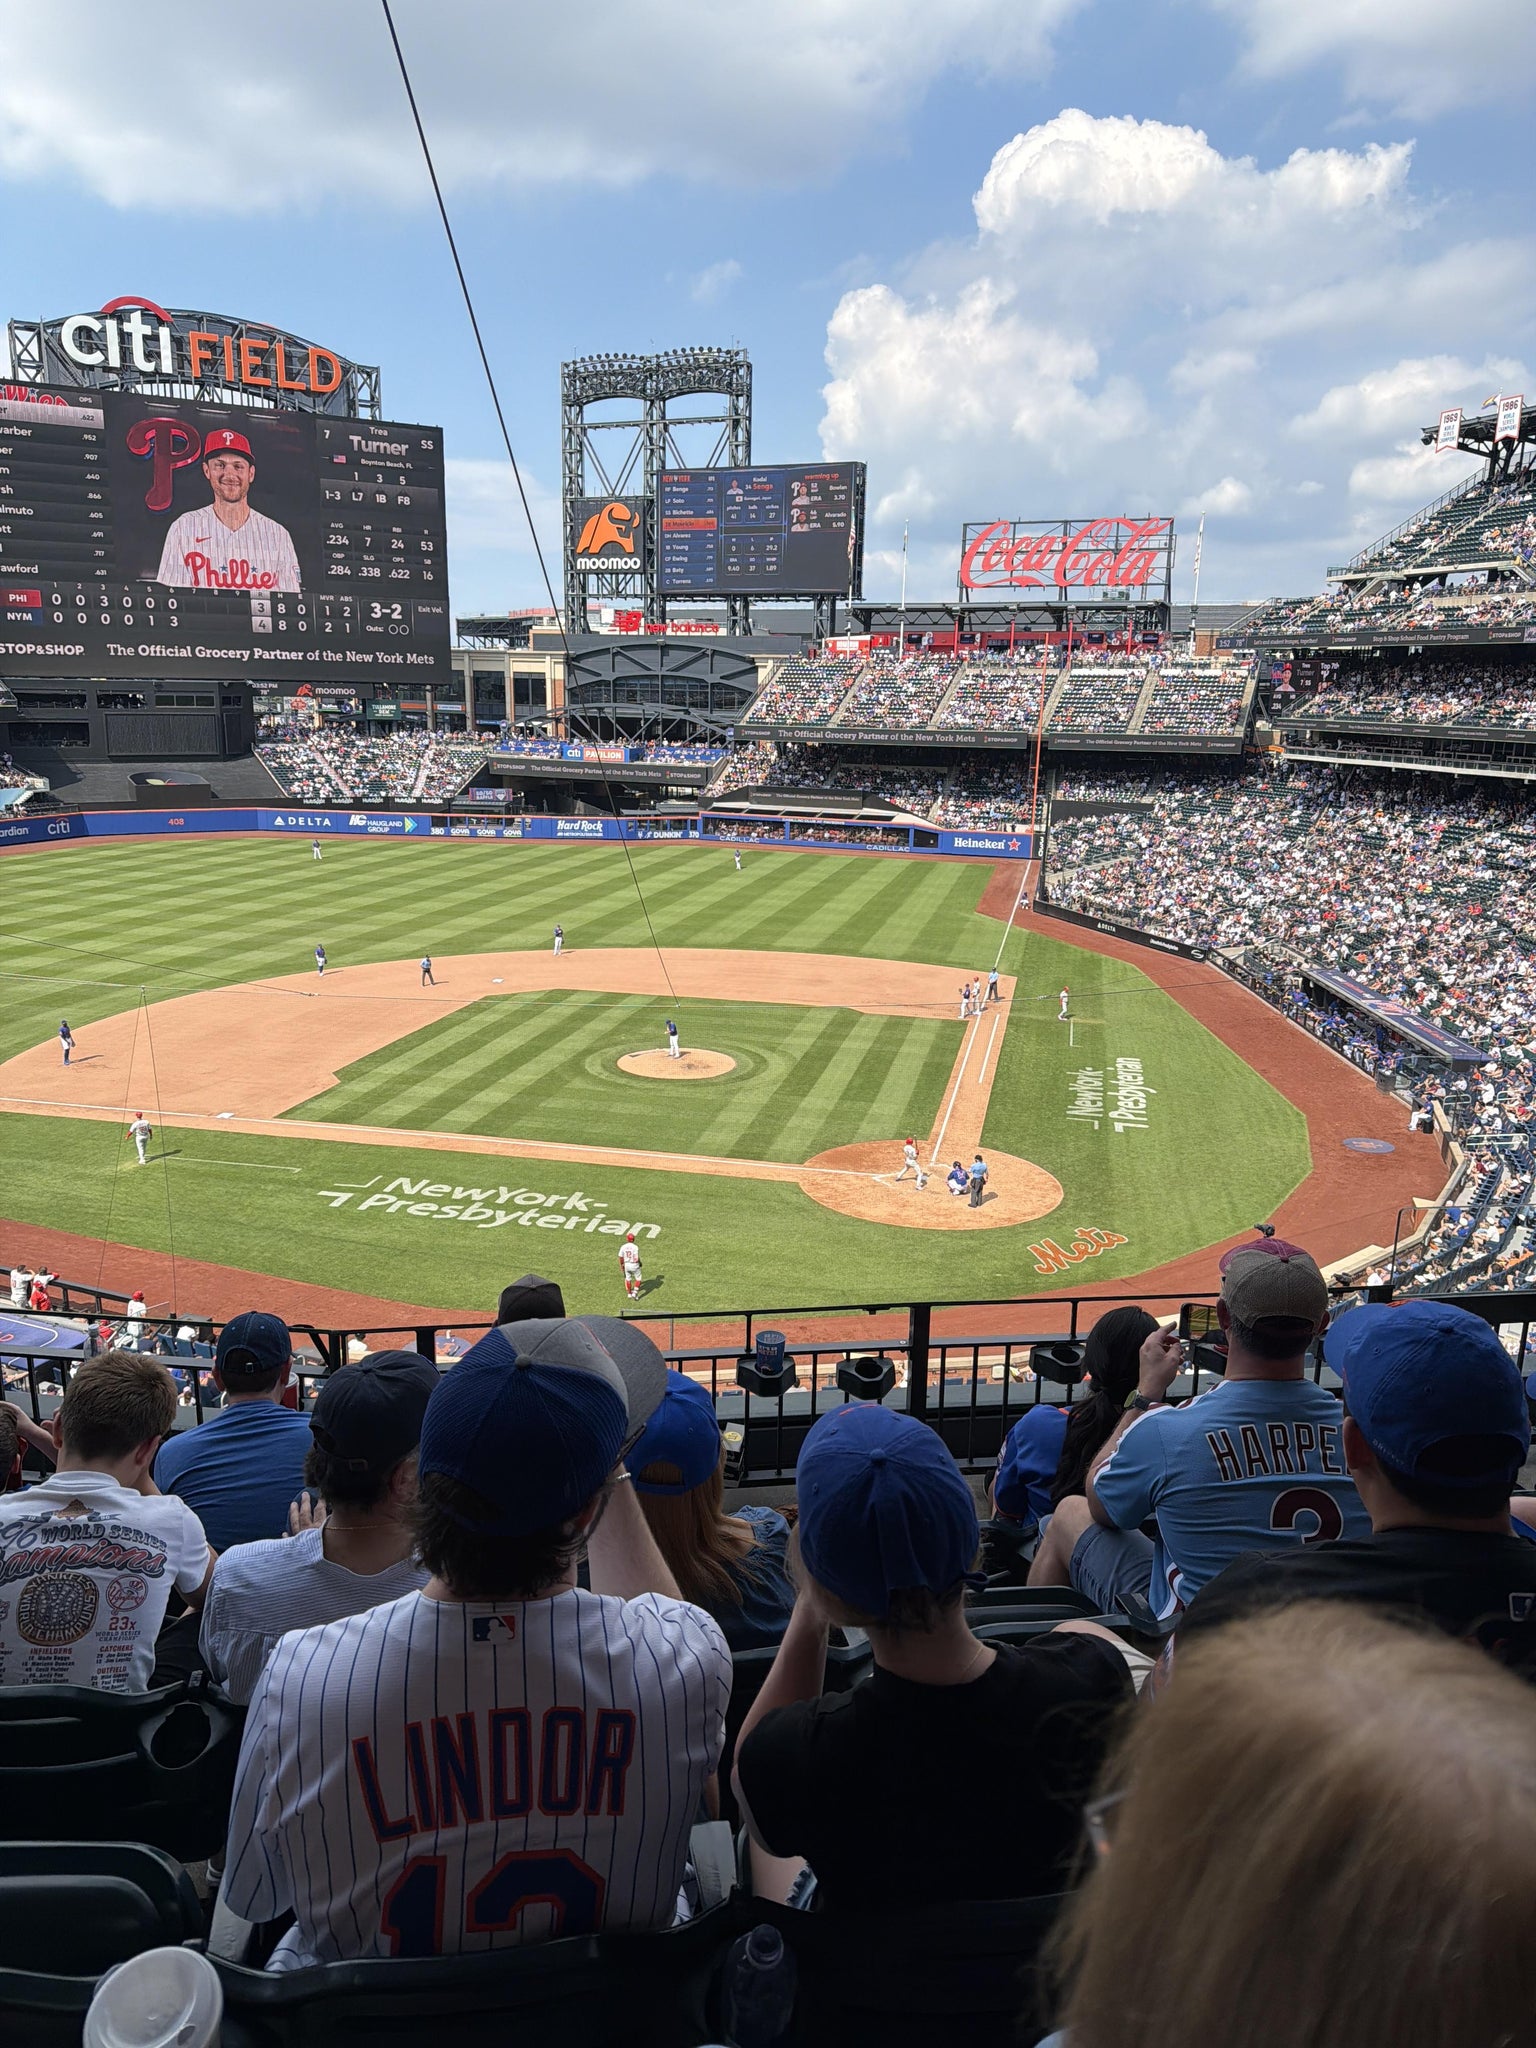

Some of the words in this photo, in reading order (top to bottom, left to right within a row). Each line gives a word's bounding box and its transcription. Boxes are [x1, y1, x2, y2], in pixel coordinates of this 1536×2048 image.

[61, 309, 173, 374] citi
[189, 331, 341, 392] FIELD
[1502, 400, 1519, 411] 1986
[1444, 413, 1458, 424] 1969
[324, 430, 330, 439] 7
[369, 427, 389, 436] Trea
[349, 435, 409, 456] Turner
[421, 440, 434, 450] SS
[354, 472, 359, 481] 1
[376, 474, 383, 483] 3
[399, 476, 406, 485] 5
[752, 483, 774, 491] Senga
[325, 490, 341, 500] 1-3
[352, 492, 364, 501] L7
[376, 494, 387, 503] 1B
[397, 496, 411, 505] F8
[326, 535, 349, 546] .234
[365, 537, 371, 547] 7
[391, 539, 405, 549] 24
[420, 541, 434, 551] 53
[960, 517, 1175, 589] Coca-Cola
[0, 564, 39, 574] awford
[576, 557, 641, 569] moomoo
[328, 565, 351, 576] .284
[358, 567, 381, 577] .338
[389, 569, 410, 579] .622
[423, 571, 434, 581] 16
[9, 594, 27, 602] PHI
[52, 593, 61, 605] 0
[76, 594, 85, 606] 0
[100, 596, 109, 607] 3
[122, 597, 132, 608] 0
[145, 597, 155, 609] 0
[168, 598, 178, 610] 0
[258, 603, 265, 613] 3
[277, 603, 286, 614] 8
[297, 604, 306, 615] 0
[325, 605, 330, 616] 1
[343, 606, 351, 617] 2
[370, 602, 403, 620] 3-2
[431, 606, 444, 614] Vel.
[7, 613, 32, 621] NYM
[53, 612, 63, 623] 0
[77, 612, 87, 624] 0
[101, 613, 111, 625] 0
[124, 614, 134, 625] 0
[148, 615, 154, 626] 1
[170, 615, 178, 627] 3
[258, 620, 266, 630] 4
[278, 620, 287, 631] 8
[298, 621, 307, 631] 0
[325, 622, 333, 633] 2
[345, 623, 350, 633] 1
[645, 623, 667, 633] new
[671, 622, 720, 633] balance
[366, 625, 384, 633] Outs:
[107, 644, 135, 656] The
[138, 644, 192, 657] Official
[195, 647, 250, 661] Grocery
[254, 647, 304, 661] Partner
[306, 650, 320, 661] of
[323, 650, 343, 661] the
[346, 651, 373, 663] New
[376, 652, 403, 664] York
[406, 653, 435, 665] Mets
[315, 687, 356, 695] moomoo
[794, 730, 824, 738] Official
[825, 731, 856, 740] Grocery
[858, 732, 889, 740] Partner
[900, 733, 913, 741] the
[935, 734, 954, 742] York
[956, 735, 976, 743] Mets
[585, 750, 622, 759] PAVILION
[168, 818, 185, 826] 408
[288, 816, 331, 827] DELTA
[367, 820, 402, 828] HAUGLAND
[557, 820, 580, 830] Hard
[581, 821, 603, 831] Rock
[47, 821, 70, 835] citi
[430, 827, 444, 835] 380
[451, 828, 470, 836] GOYA
[477, 828, 496, 836] GOYA
[503, 829, 522, 837] GOYA
[653, 831, 683, 839] DUNKIN'
[719, 835, 760, 844] CADILLAC
[866, 844, 911, 852] CADILLAC
[954, 837, 1005, 850] Heineken
[1106, 1057, 1157, 1121] Presbyterian
[357, 1193, 662, 1239] Presbyterian
[1027, 1227, 1128, 1274] Mets
[1205, 1421, 1351, 1482] HARPE
[0, 1521, 42, 1549] 96
[40, 1523, 106, 1545] WORLD
[109, 1524, 168, 1554] SERIES
[36, 1595, 96, 1641] CHAMPIONS
[109, 1616, 137, 1630] 23x
[30, 1647, 72, 1655] INFIELDERS
[100, 1644, 133, 1652] CATCHERS
[97, 1666, 127, 1674] OUTFIELD
[352, 1706, 636, 1843] LINDOR
